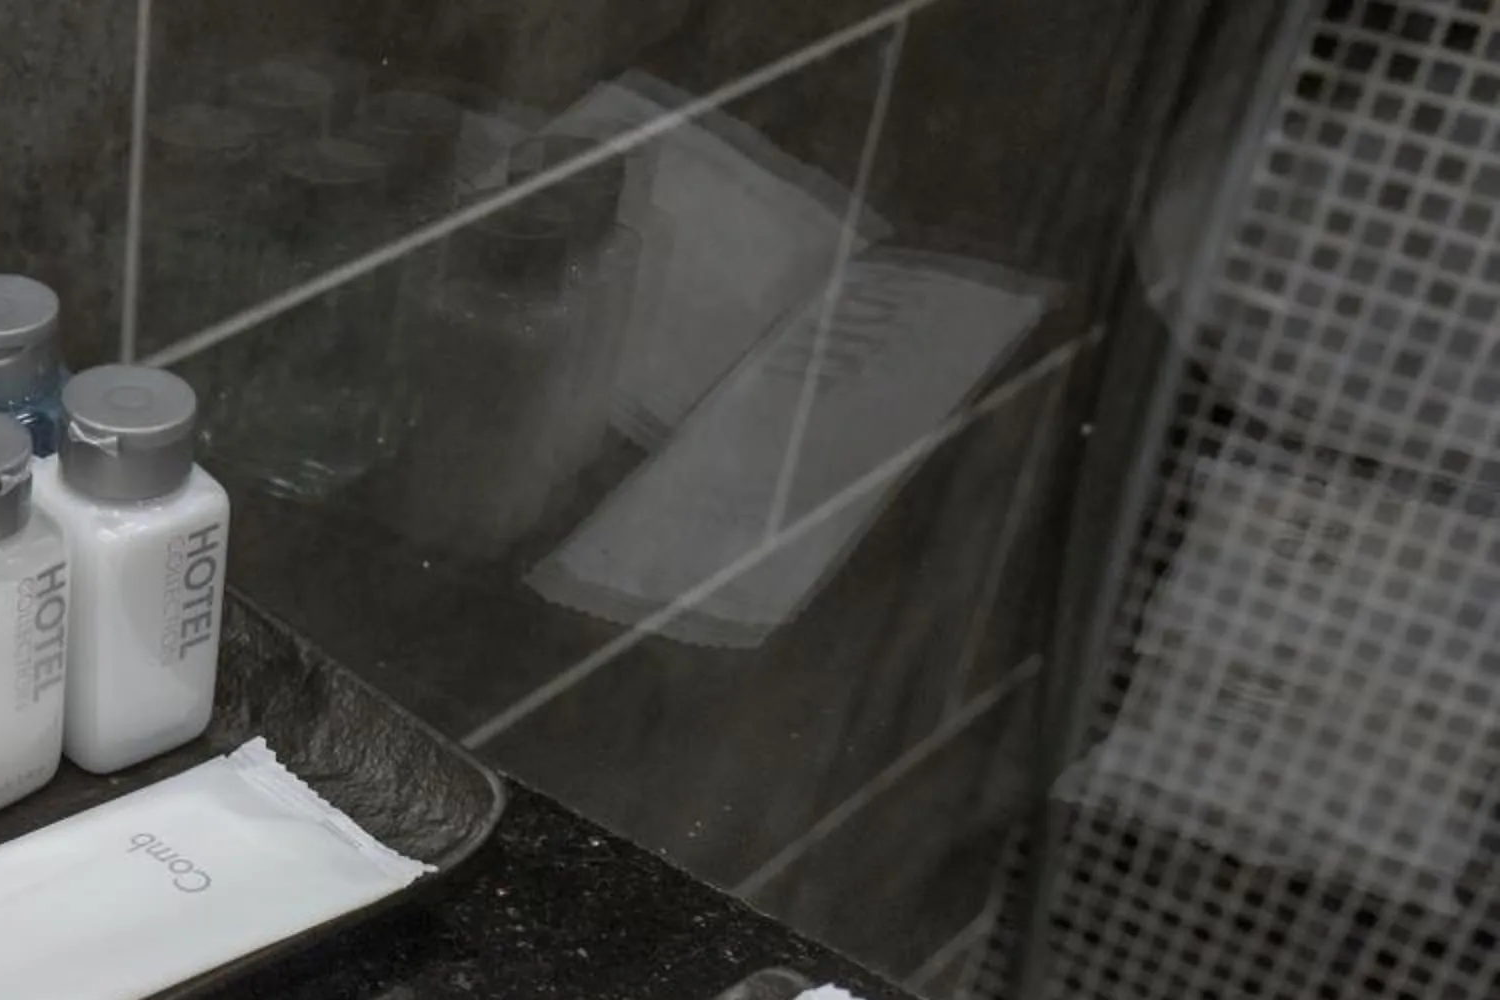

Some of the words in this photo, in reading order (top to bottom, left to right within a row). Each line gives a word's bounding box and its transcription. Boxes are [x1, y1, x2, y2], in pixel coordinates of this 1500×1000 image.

[33, 560, 67, 703] HOTEL
[179, 522, 220, 660] HOTEL
[126, 832, 212, 893] Comb
